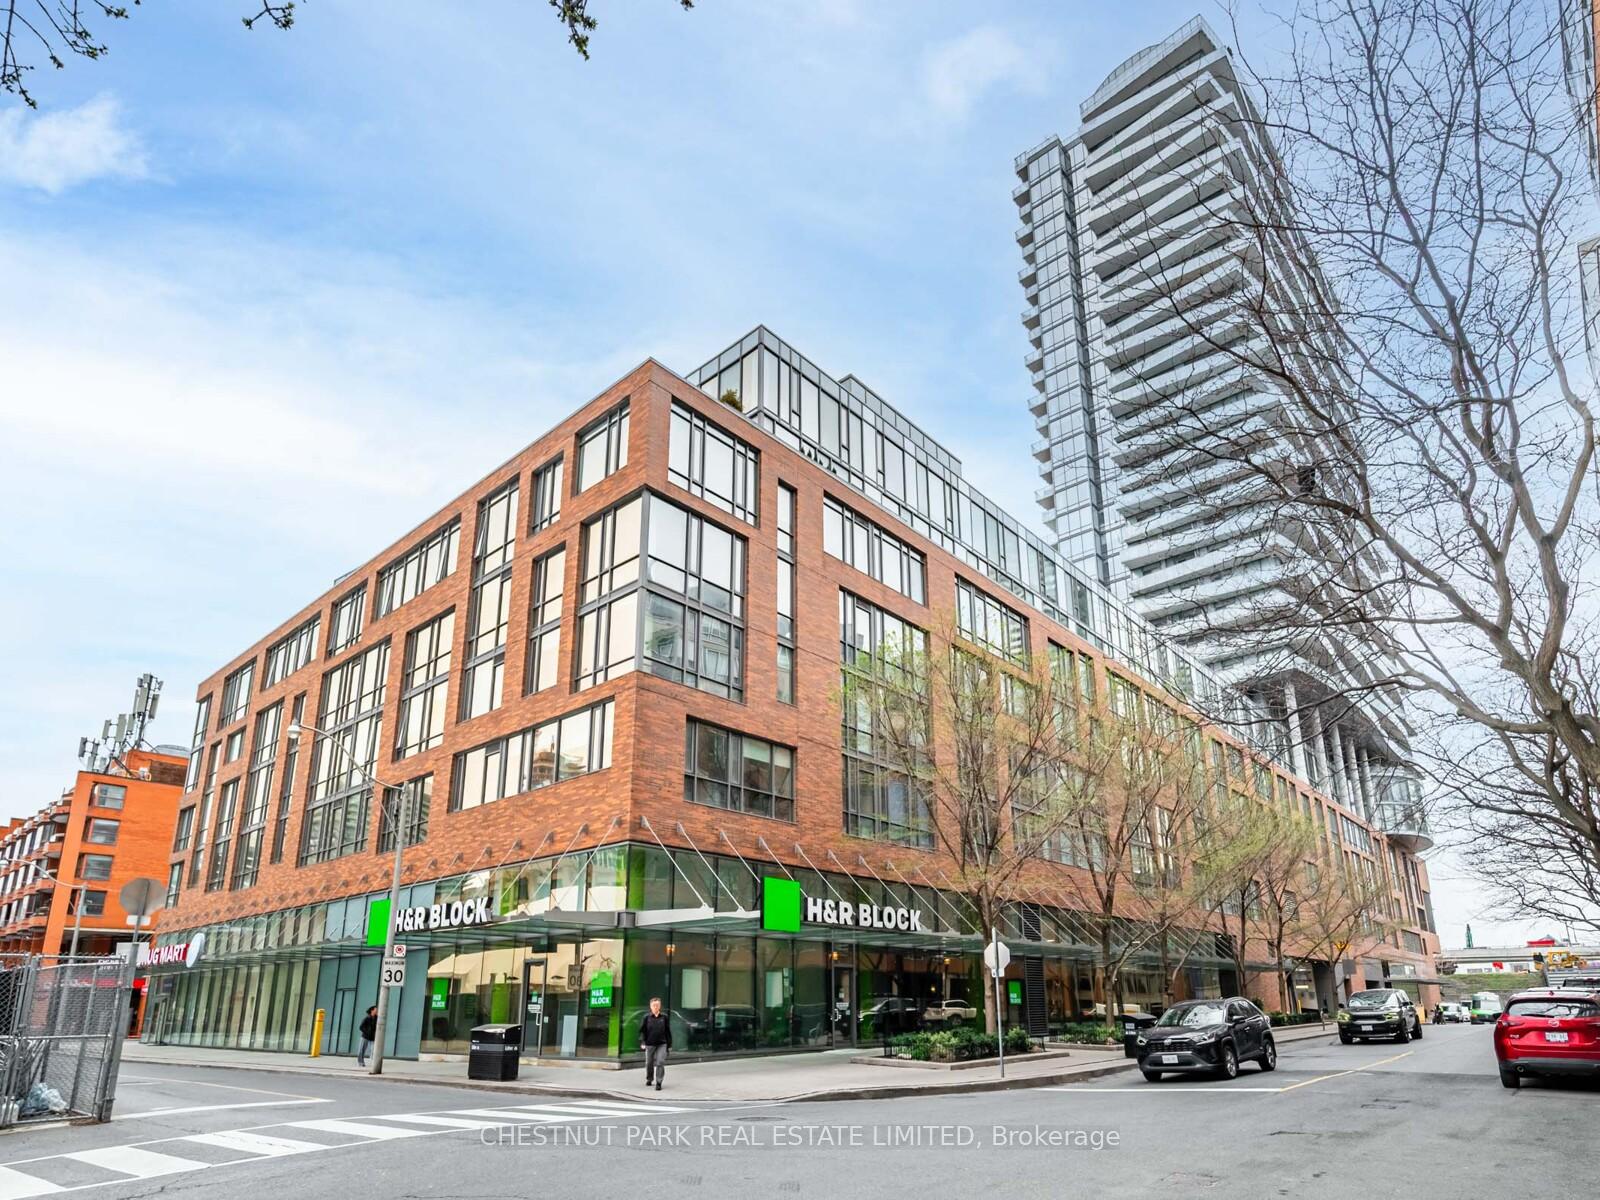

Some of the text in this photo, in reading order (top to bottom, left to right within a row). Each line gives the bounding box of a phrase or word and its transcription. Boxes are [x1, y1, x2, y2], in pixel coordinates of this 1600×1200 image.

[395, 896, 488, 932] H&R BLOCK
[806, 896, 921, 931] H&R BLOCK
[160, 943, 186, 964] MART
[383, 969, 403, 983] 30
[591, 989, 604, 997] H&R
[591, 997, 610, 1005] BLOCK
